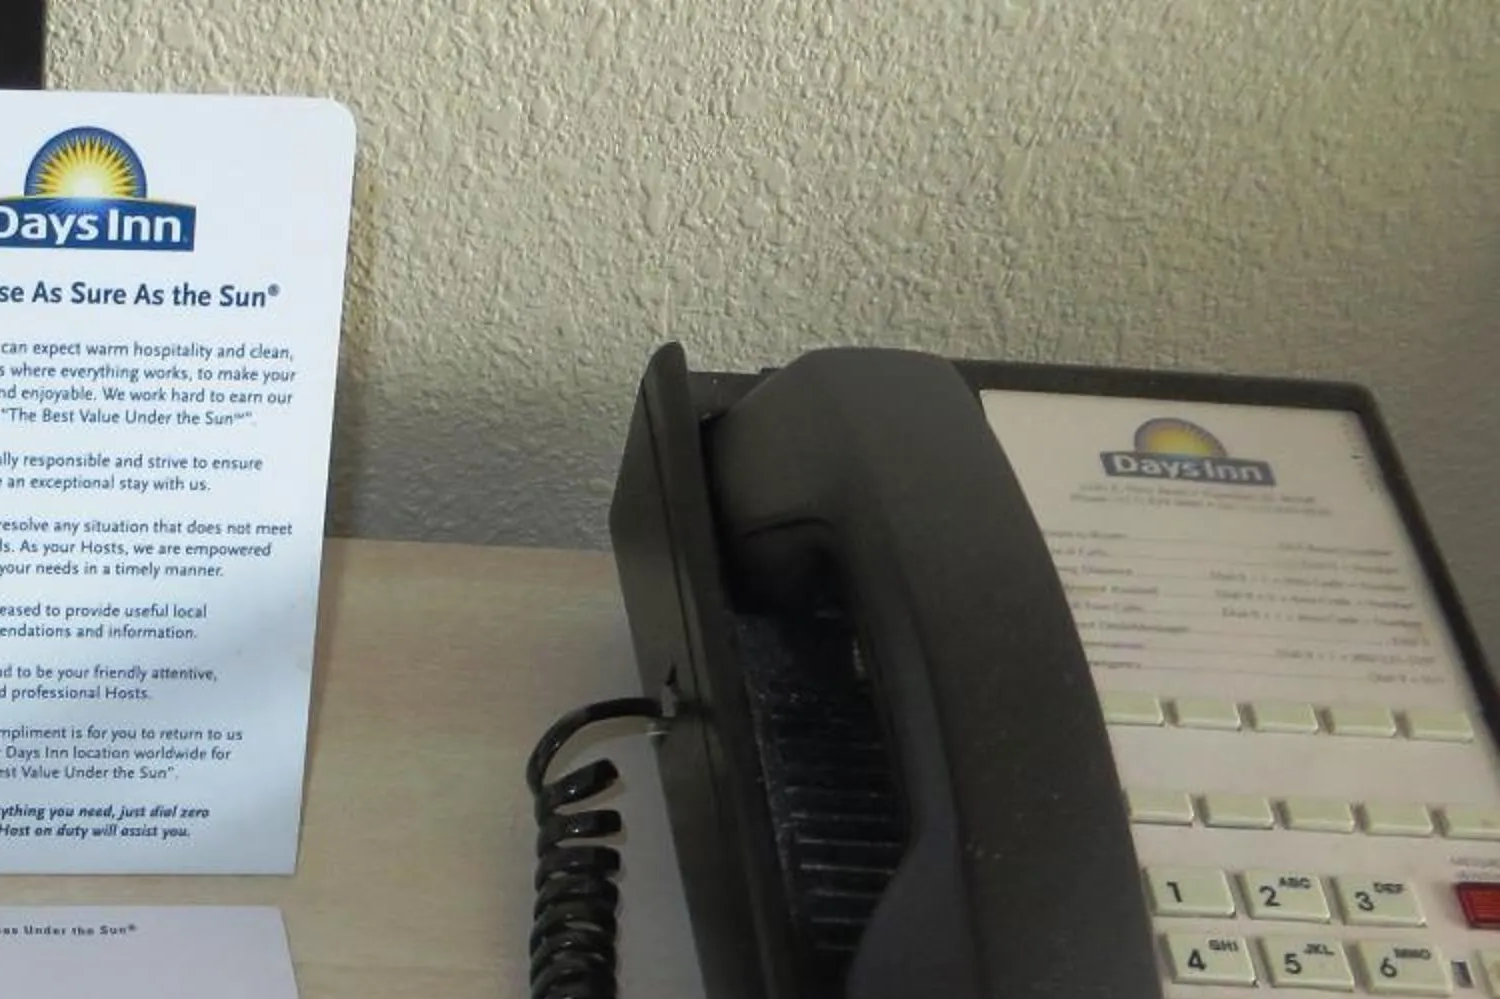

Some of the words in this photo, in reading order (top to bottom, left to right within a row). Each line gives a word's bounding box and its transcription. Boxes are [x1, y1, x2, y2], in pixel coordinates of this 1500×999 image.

[107, 209, 181, 243] Inn
[31, 281, 63, 304] As
[70, 281, 127, 305] Sure
[133, 283, 165, 306] As
[171, 282, 212, 307] the
[0, 342, 29, 355] can
[32, 343, 81, 359] expect
[85, 344, 129, 357] warm
[133, 341, 213, 361] hospitality
[216, 343, 246, 359] and
[249, 343, 293, 362] clean,
[9, 361, 57, 378] where
[59, 364, 140, 384] everything
[143, 365, 193, 382] works,
[197, 367, 214, 381] to
[216, 365, 260, 382] make
[261, 370, 297, 386] your
[20, 385, 97, 405] enjoyable.
[101, 385, 126, 402] We
[129, 387, 168, 402] work
[170, 387, 206, 404] hard
[209, 390, 226, 404] to
[228, 392, 264, 404] earn
[266, 392, 293, 405] our
[41, 407, 75, 424] Best
[78, 408, 121, 424] Value
[124, 409, 173, 425] Under
[175, 409, 201, 426] the
[23, 452, 111, 470] responsible
[114, 453, 144, 469] and
[147, 456, 189, 469] strive
[192, 456, 209, 470] to
[211, 459, 263, 471] ensure
[1112, 454, 1199, 479] Days
[1203, 460, 1264, 481] Inn
[6, 477, 26, 489] an
[29, 475, 115, 492] exceptional
[119, 477, 150, 494] stay
[152, 475, 185, 491] with
[188, 479, 211, 492] us.
[45, 604, 61, 617] to
[64, 603, 121, 621] provide
[123, 602, 169, 619] useful
[173, 603, 207, 619] local
[75, 623, 105, 639] and
[48, 807, 75, 824] you
[117, 805, 146, 822] just
[149, 804, 177, 818] dial
[180, 808, 210, 819] zero
[33, 826, 53, 837] on
[55, 823, 89, 840] duty
[90, 823, 118, 837] will
[119, 824, 159, 837] assist
[1167, 882, 1183, 903] 1
[1259, 886, 1280, 908] 2
[1278, 877, 1312, 890] ABC
[1355, 891, 1375, 912] 3
[1373, 881, 1405, 895] DEF
[24, 925, 66, 936] Under
[1187, 950, 1207, 972] 4
[1208, 938, 1239, 952] GHI
[1284, 953, 1303, 975] 5
[1303, 943, 1336, 957] JKL
[1380, 957, 1398, 979] 6
